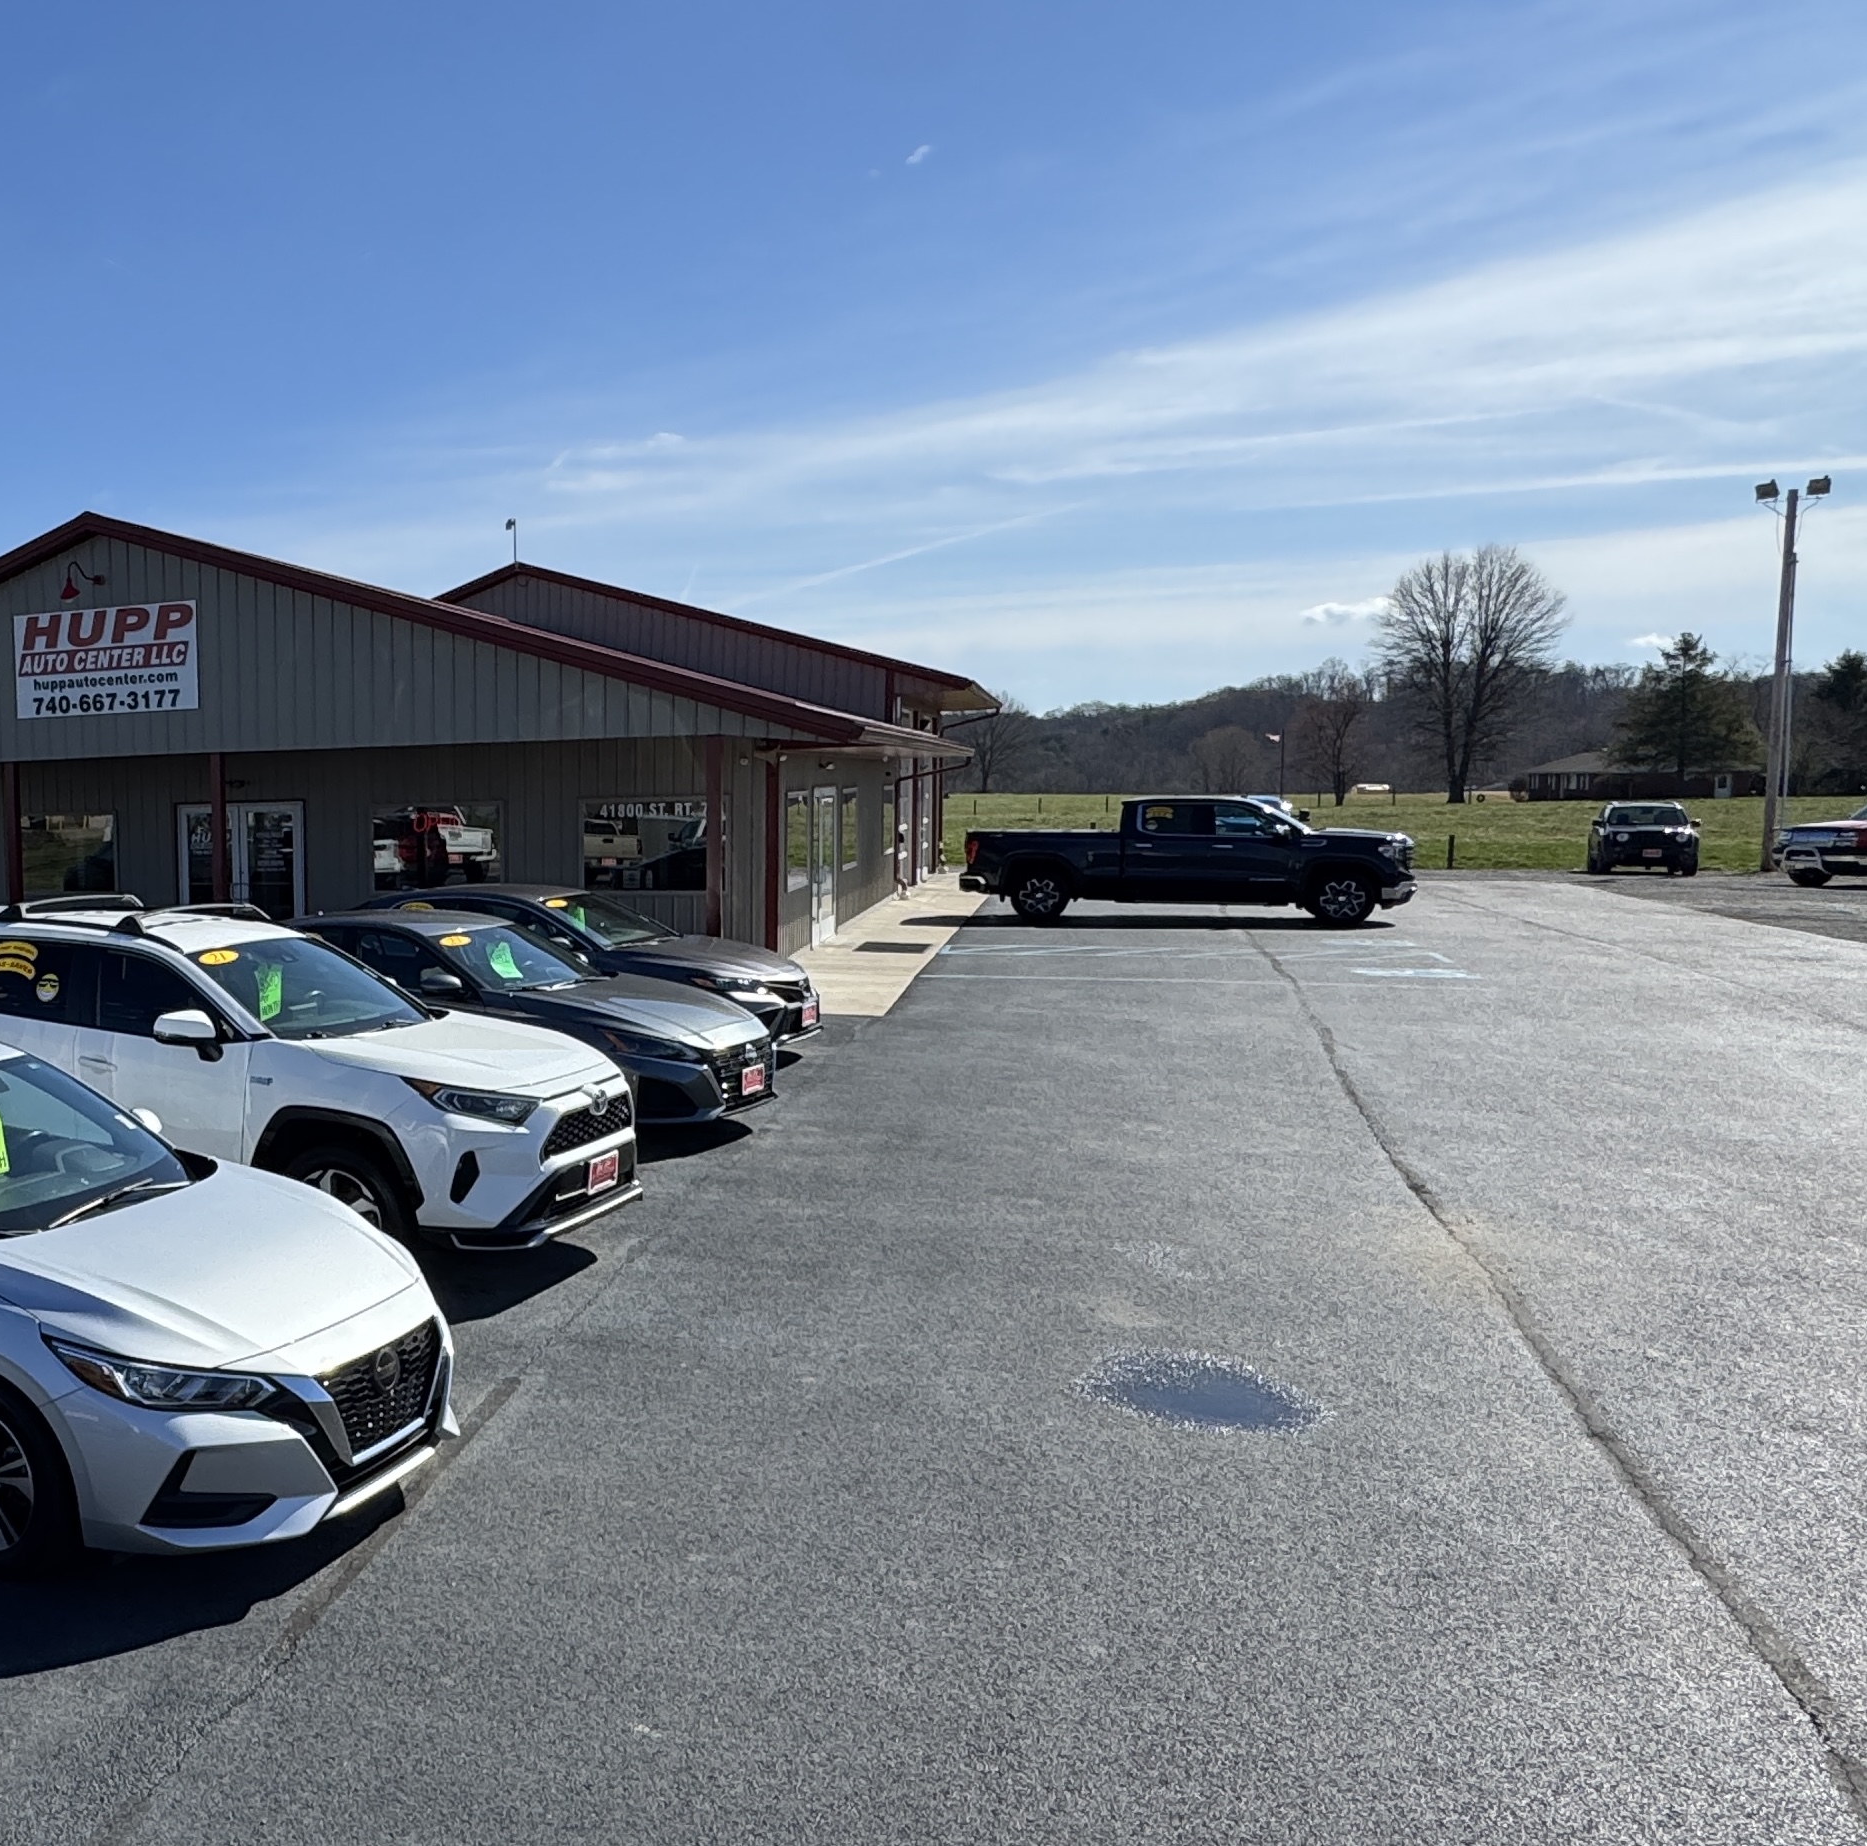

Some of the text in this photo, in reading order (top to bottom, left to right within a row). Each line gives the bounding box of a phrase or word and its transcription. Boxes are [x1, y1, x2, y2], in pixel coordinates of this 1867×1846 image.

[22, 604, 194, 651] HUPP
[21, 644, 186, 675] AUTO CENTER LLC
[34, 672, 178, 693] huppautocenter.com
[33, 689, 181, 715] 740-667-3177
[600, 804, 643, 818] 41800
